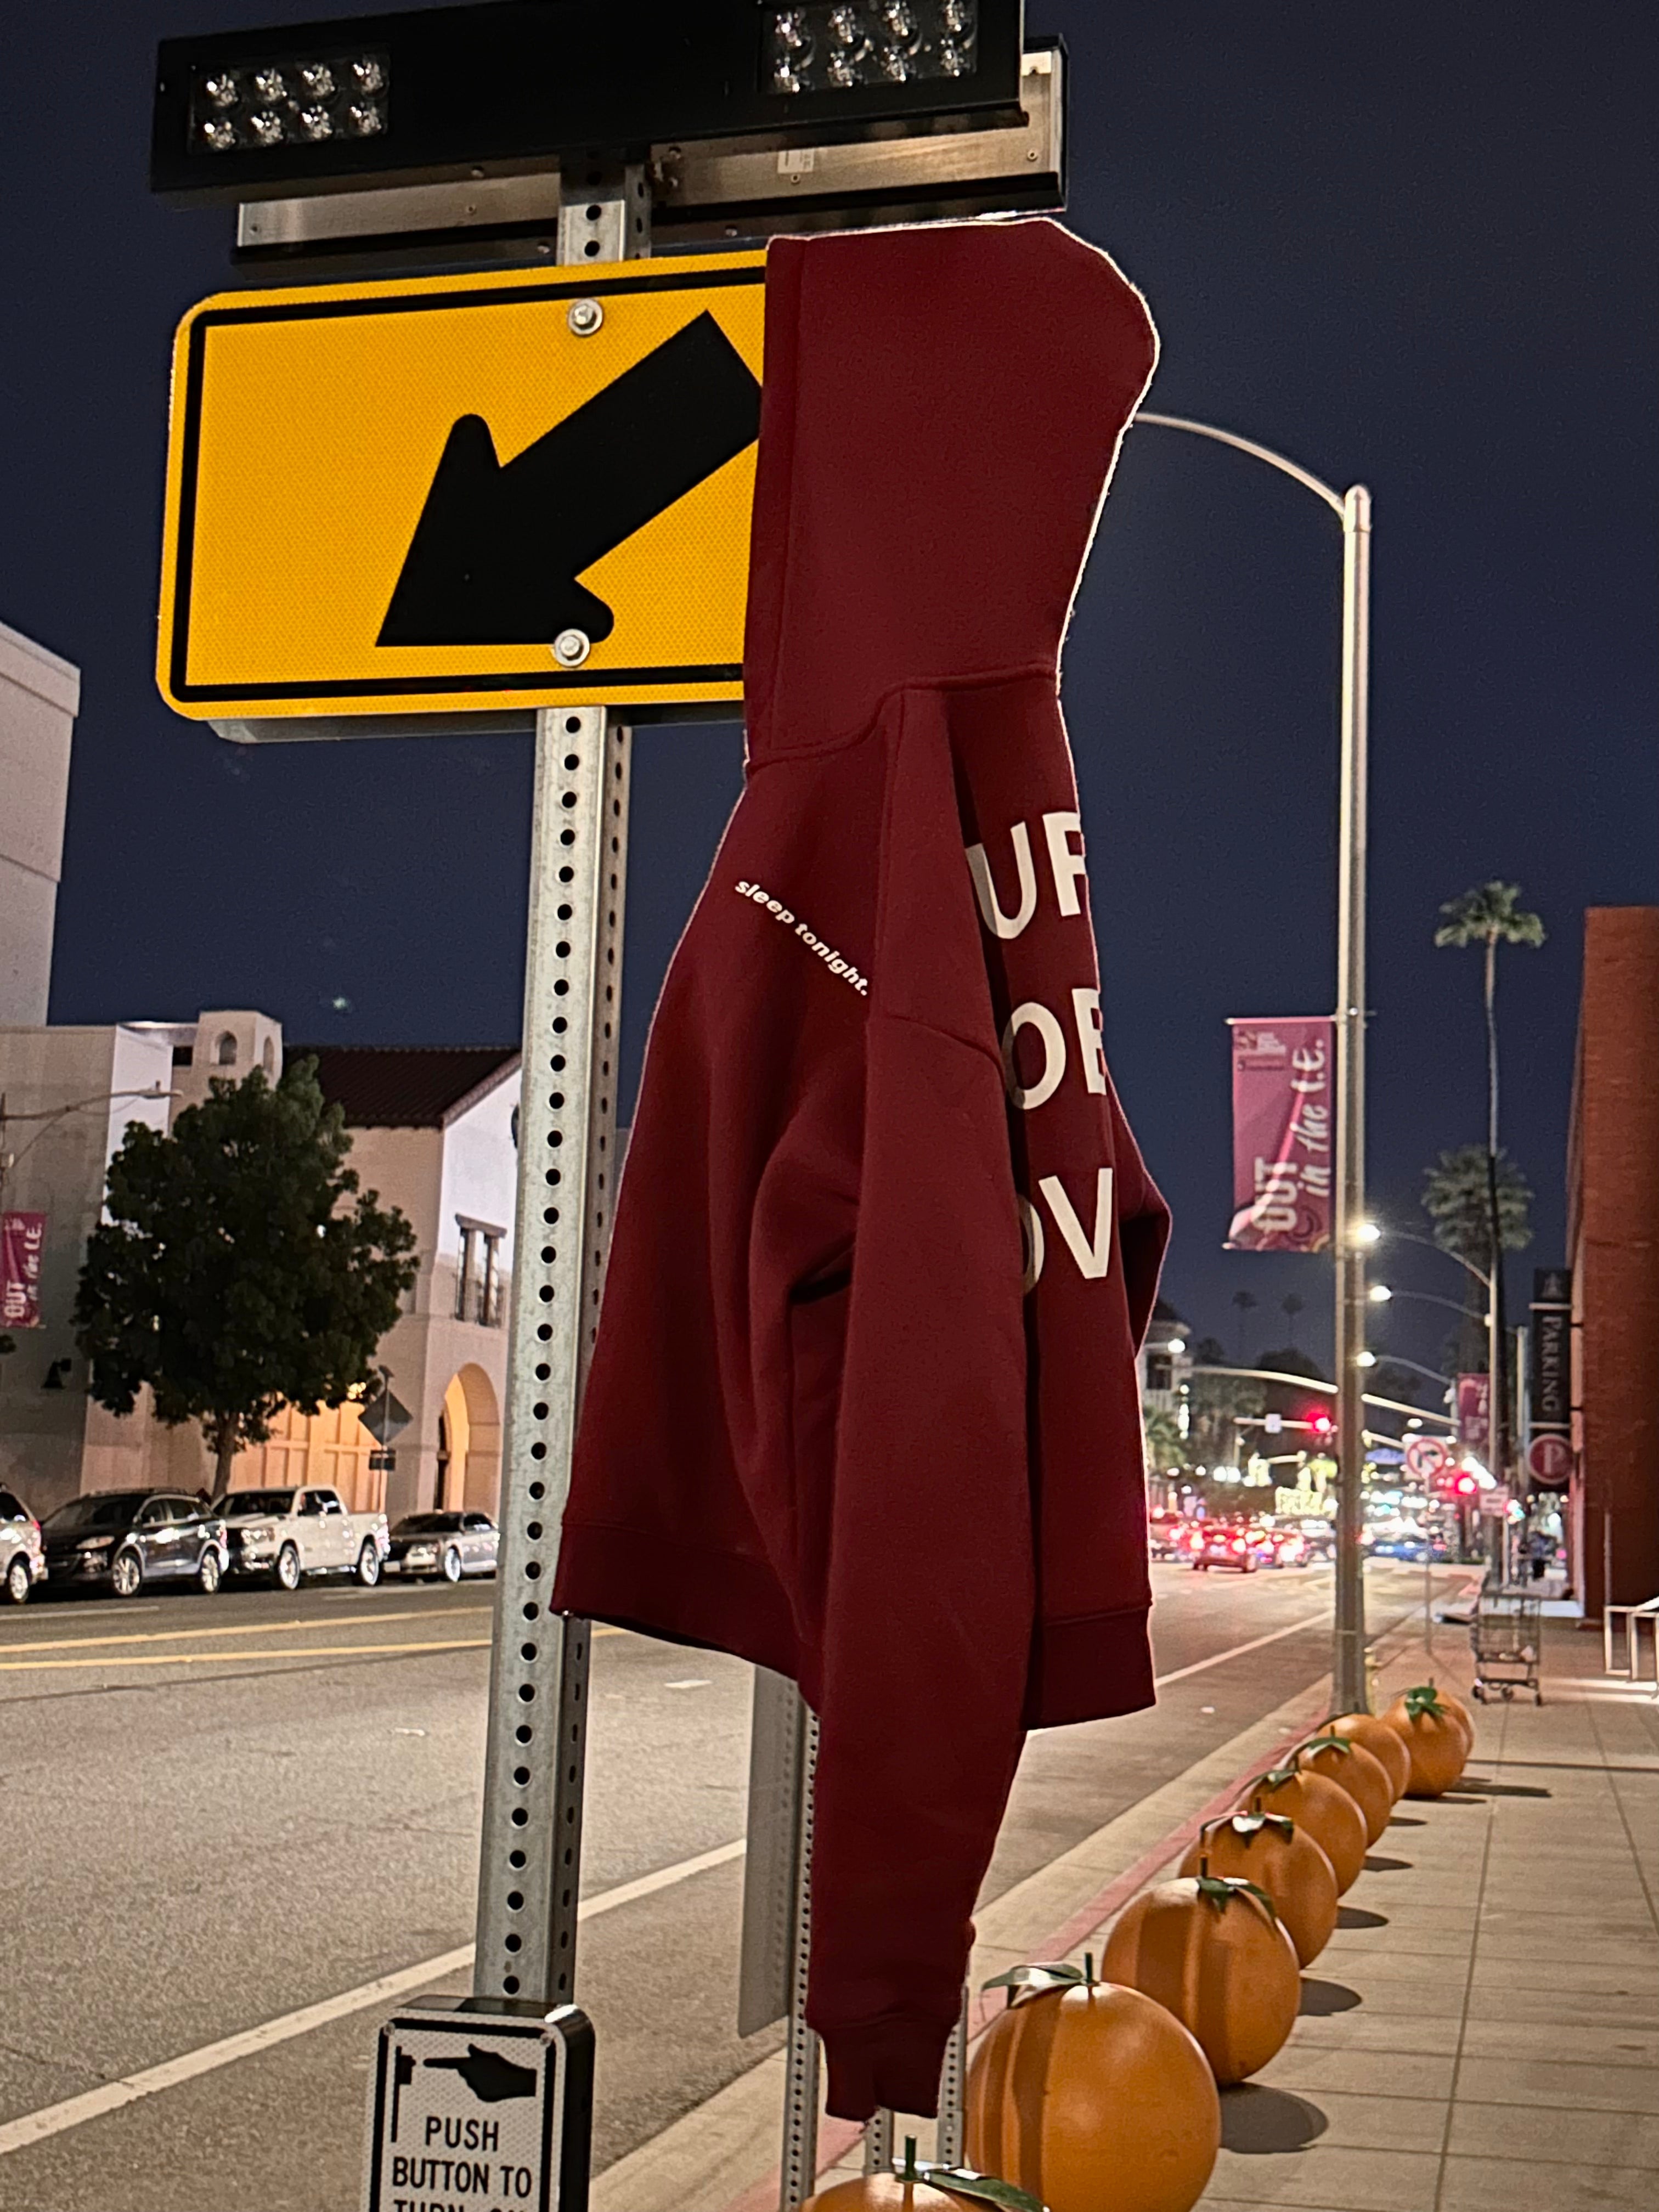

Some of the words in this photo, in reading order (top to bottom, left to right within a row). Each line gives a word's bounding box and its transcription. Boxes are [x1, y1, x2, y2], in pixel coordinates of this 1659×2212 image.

[735, 881, 795, 924] sleep
[795, 923, 868, 996] tonight.
[1292, 1104, 1329, 1153] the
[1252, 1156, 1298, 1232] OUT
[1297, 1164, 1330, 1198] in
[4, 1280, 26, 1318] OUT
[1542, 1315, 1562, 1412] PARKING
[1542, 1442, 1565, 1475] P
[426, 2116, 499, 2152] PUSH
[392, 2156, 489, 2194] BUTTON
[500, 2165, 532, 2198] TO
